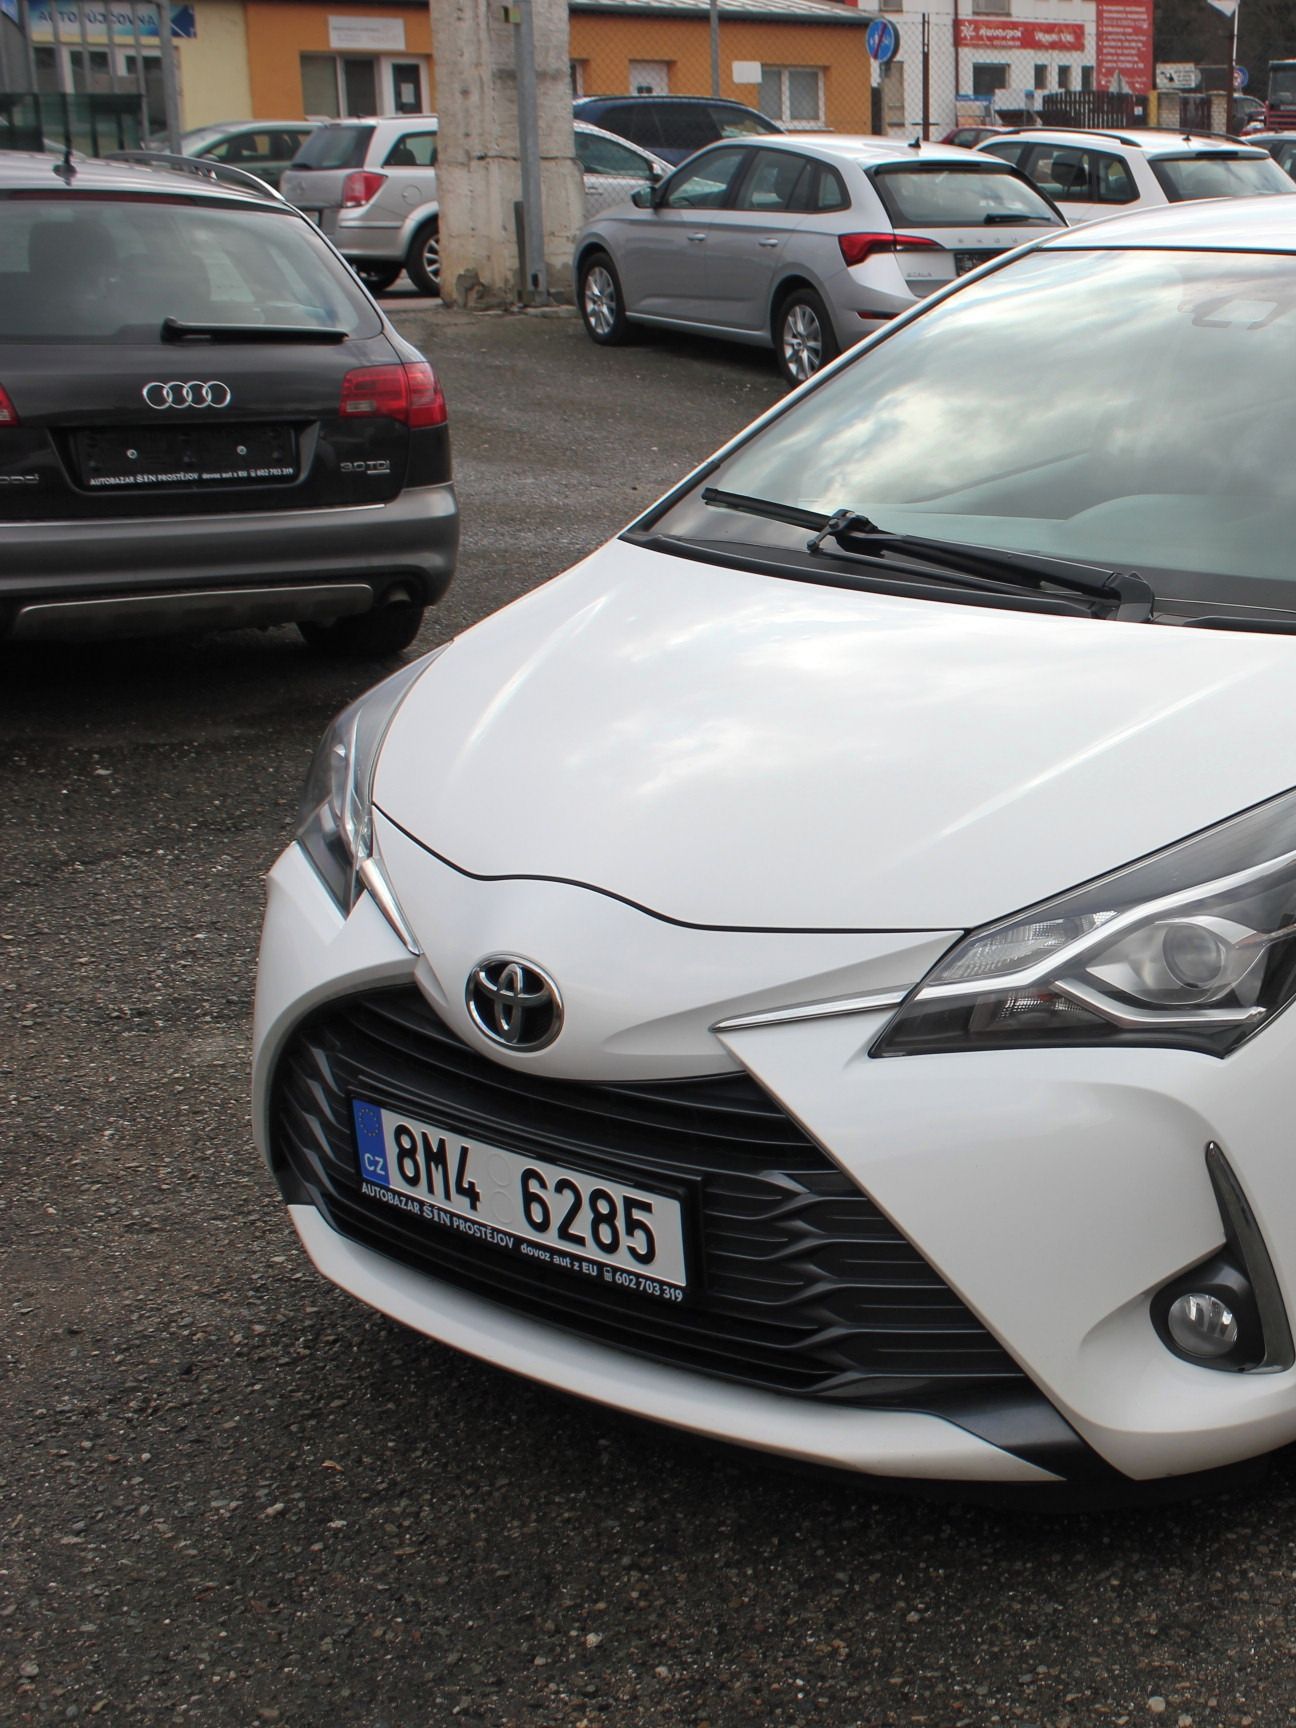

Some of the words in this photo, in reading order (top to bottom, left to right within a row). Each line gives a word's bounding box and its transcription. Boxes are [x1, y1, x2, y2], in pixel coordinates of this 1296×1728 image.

[89, 476, 135, 486] AUTOBAZAR
[364, 1152, 386, 1176] CZ
[393, 1121, 482, 1212] 8M4
[519, 1166, 657, 1266] 6285
[361, 1182, 421, 1214] AUTOBAZAR
[422, 1203, 451, 1226] ŠÍN
[520, 1242, 551, 1262] dovoz
[552, 1254, 572, 1268] aut
[573, 1261, 580, 1271] z
[582, 1261, 598, 1276] EU
[615, 1271, 637, 1289] 602
[638, 1278, 661, 1296] 703
[662, 1285, 684, 1302] 319
